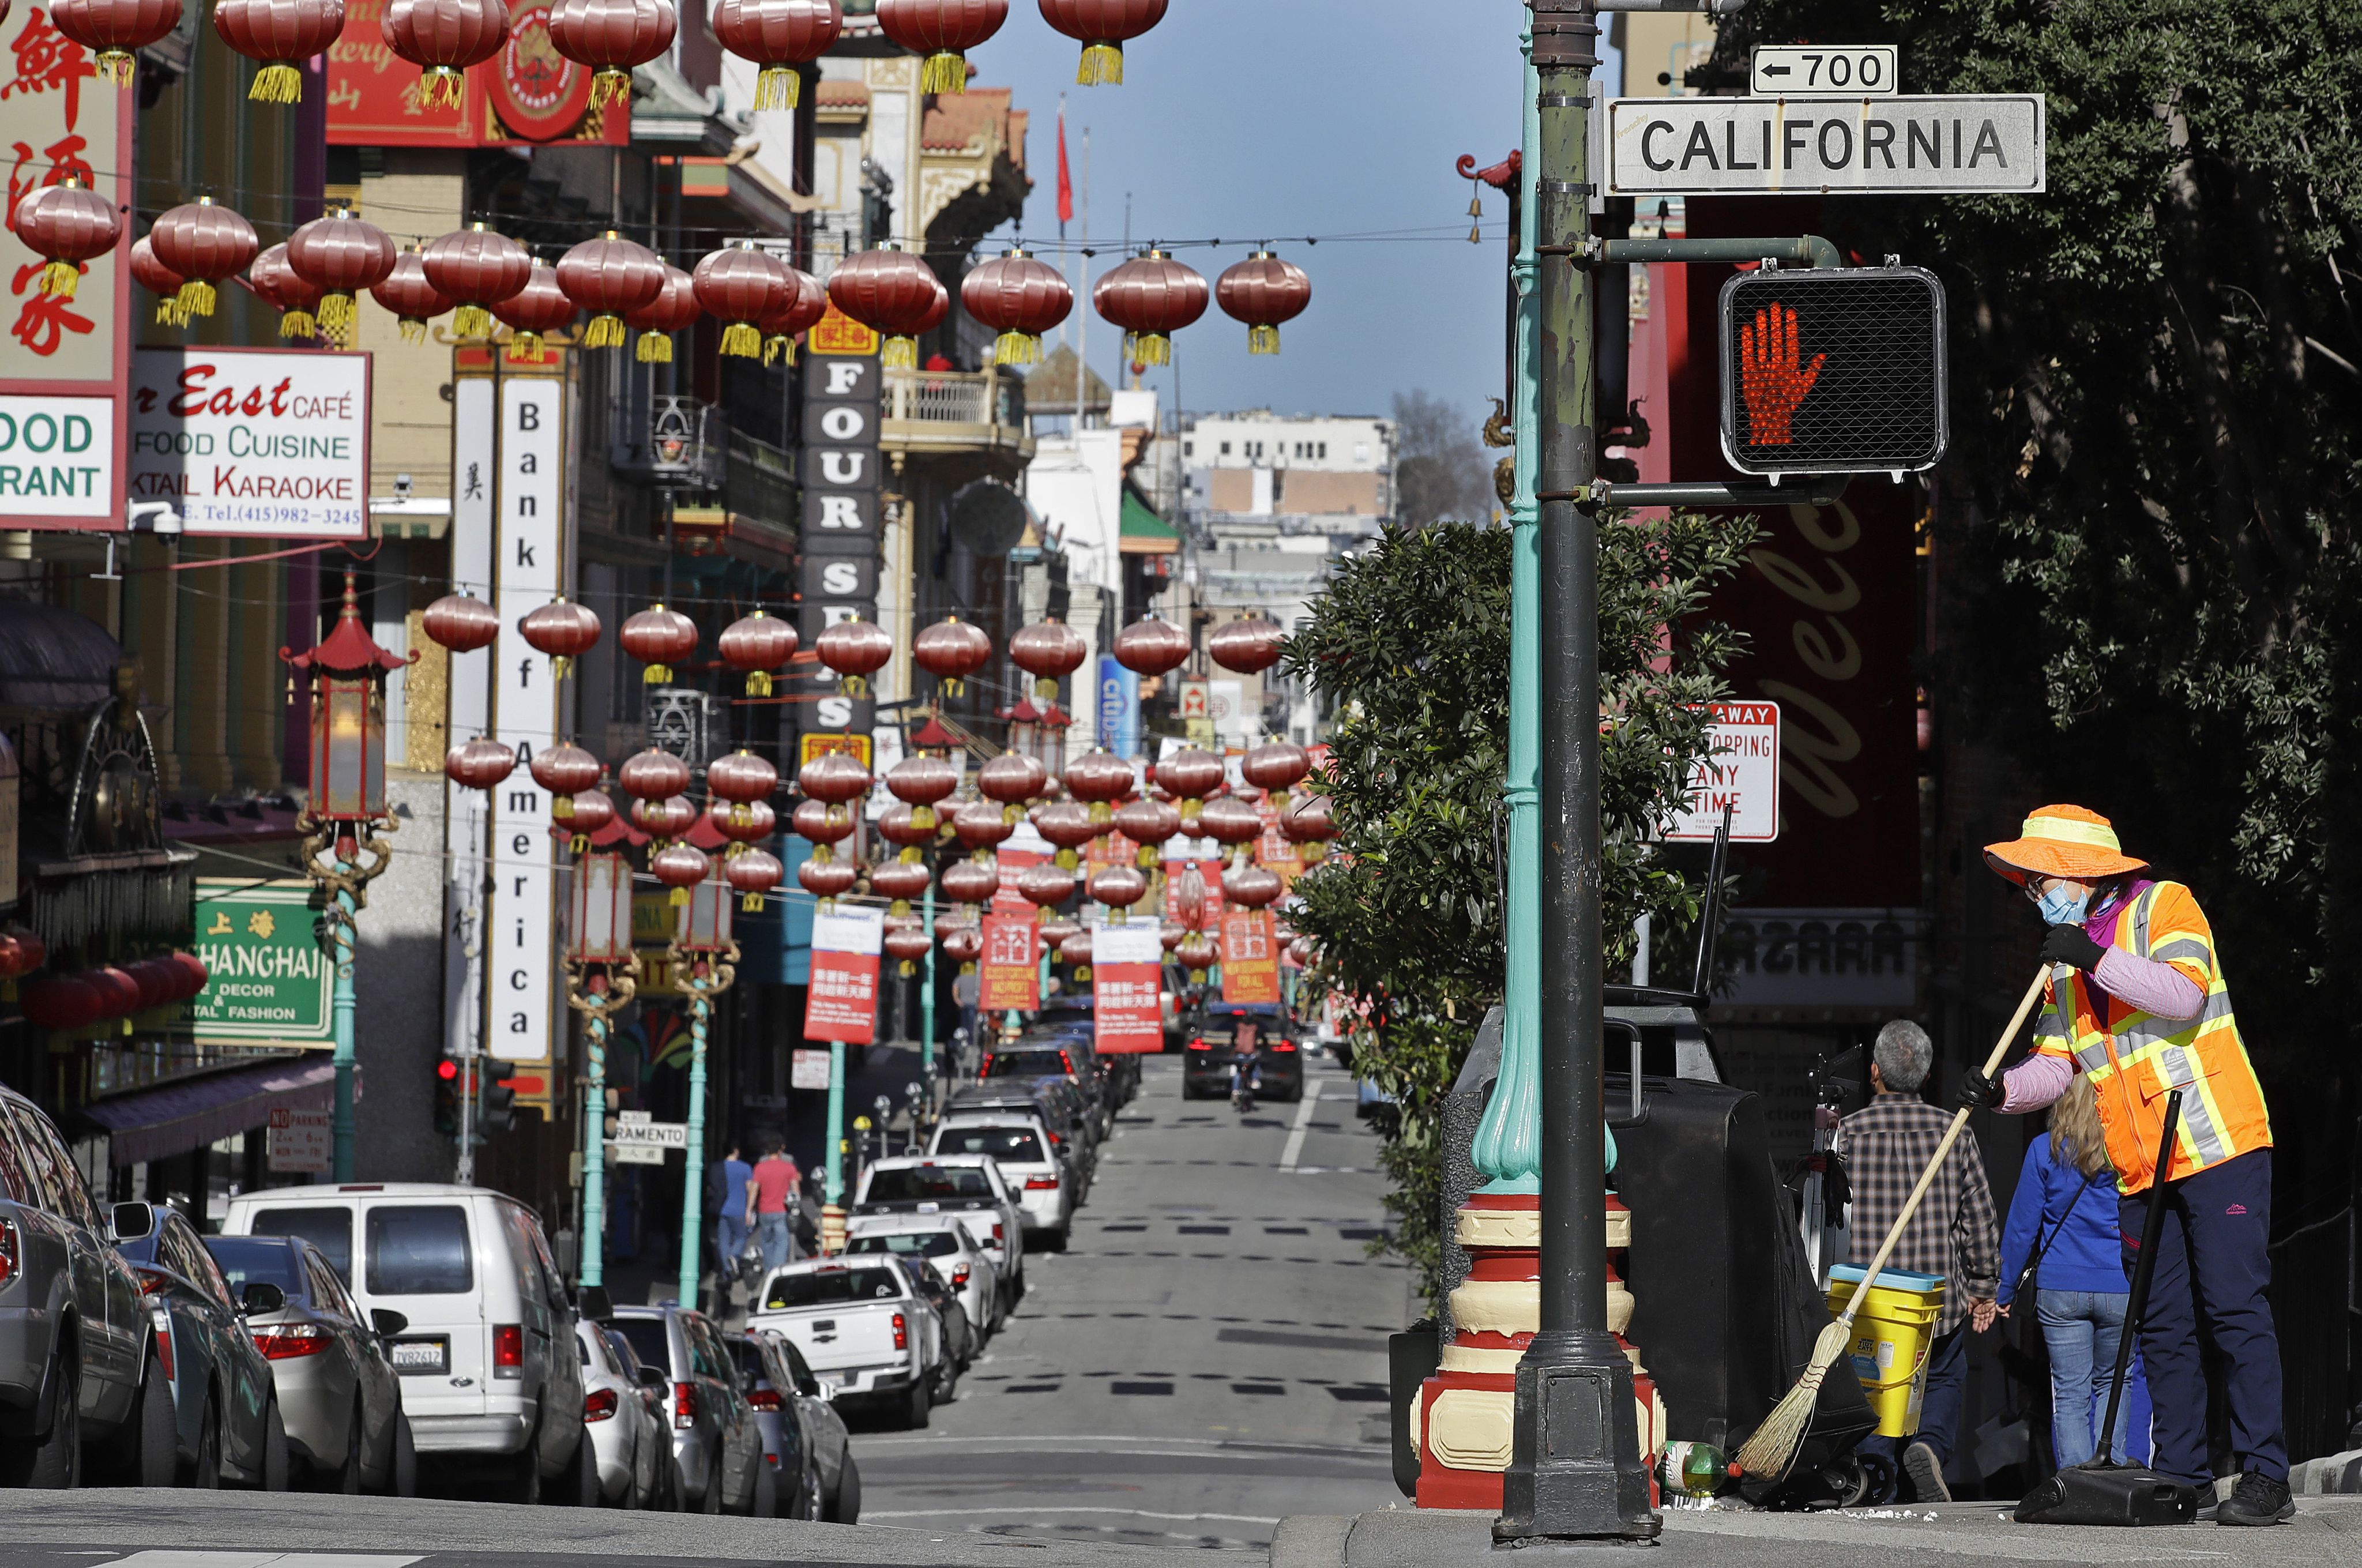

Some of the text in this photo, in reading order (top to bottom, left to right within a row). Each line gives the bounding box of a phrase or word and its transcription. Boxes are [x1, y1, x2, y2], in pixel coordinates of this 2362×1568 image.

[1801, 55, 1882, 87] 700
[1641, 119, 2009, 171] CALIFORNIA
[168, 364, 292, 418] East
[292, 390, 352, 420] CAFÉ
[134, 431, 215, 457] FOOD
[819, 362, 865, 529] FOUR
[214, 465, 353, 501] KARAOKE
[517, 402, 540, 568] Bank
[1695, 765, 1739, 787] ANY
[1691, 792, 1742, 814] TIME
[509, 741, 537, 1033] America
[213, 994, 224, 1007] &
[219, 983, 275, 998] DECOR
[228, 1006, 296, 1021] FASHION
